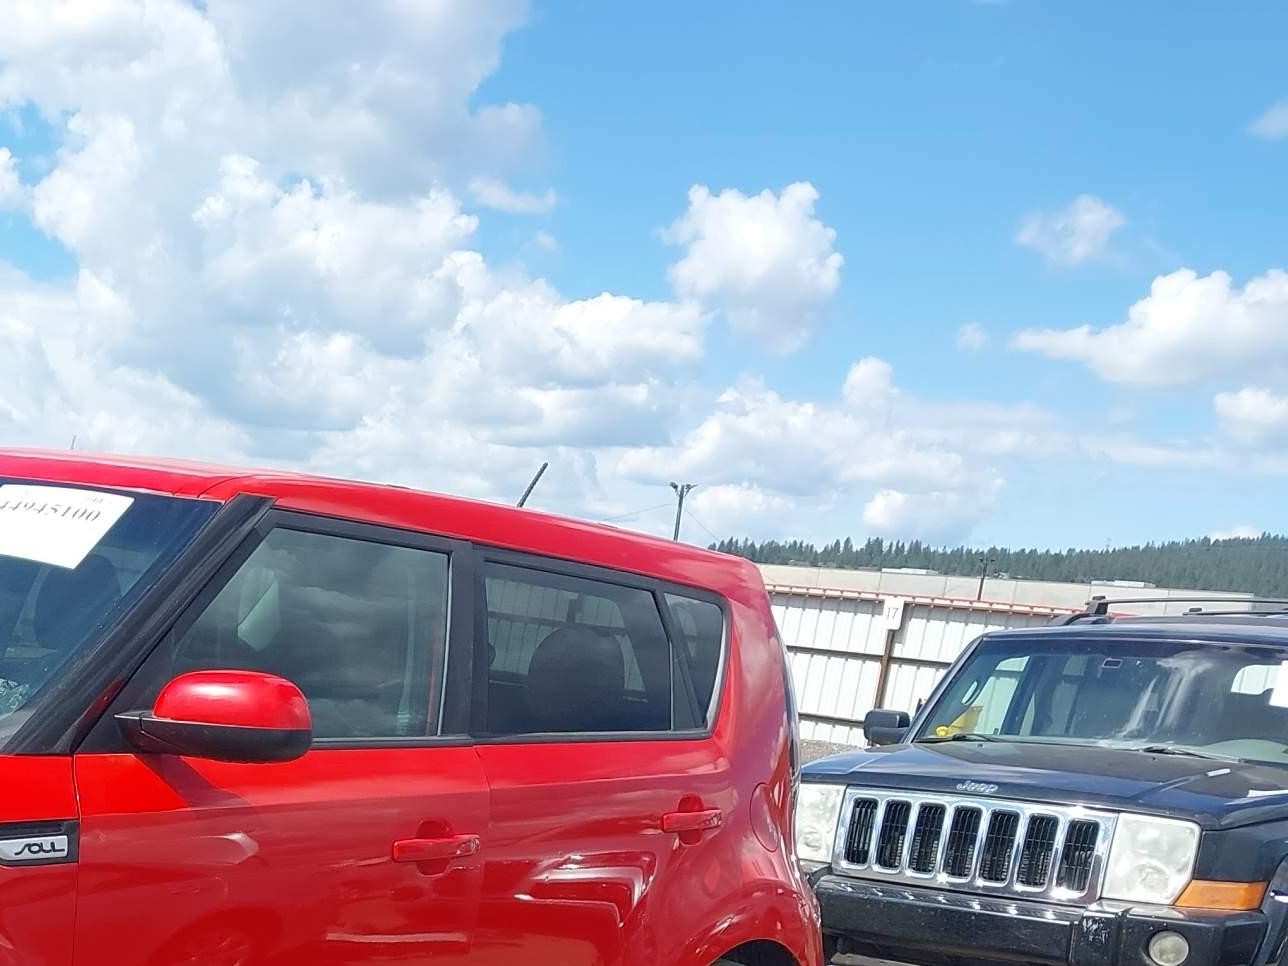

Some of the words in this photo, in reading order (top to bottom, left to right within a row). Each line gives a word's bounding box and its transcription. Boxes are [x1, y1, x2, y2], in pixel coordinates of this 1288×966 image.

[886, 607, 899, 620] 17
[955, 780, 1000, 794] Jeep
[14, 841, 65, 856] SOUL
